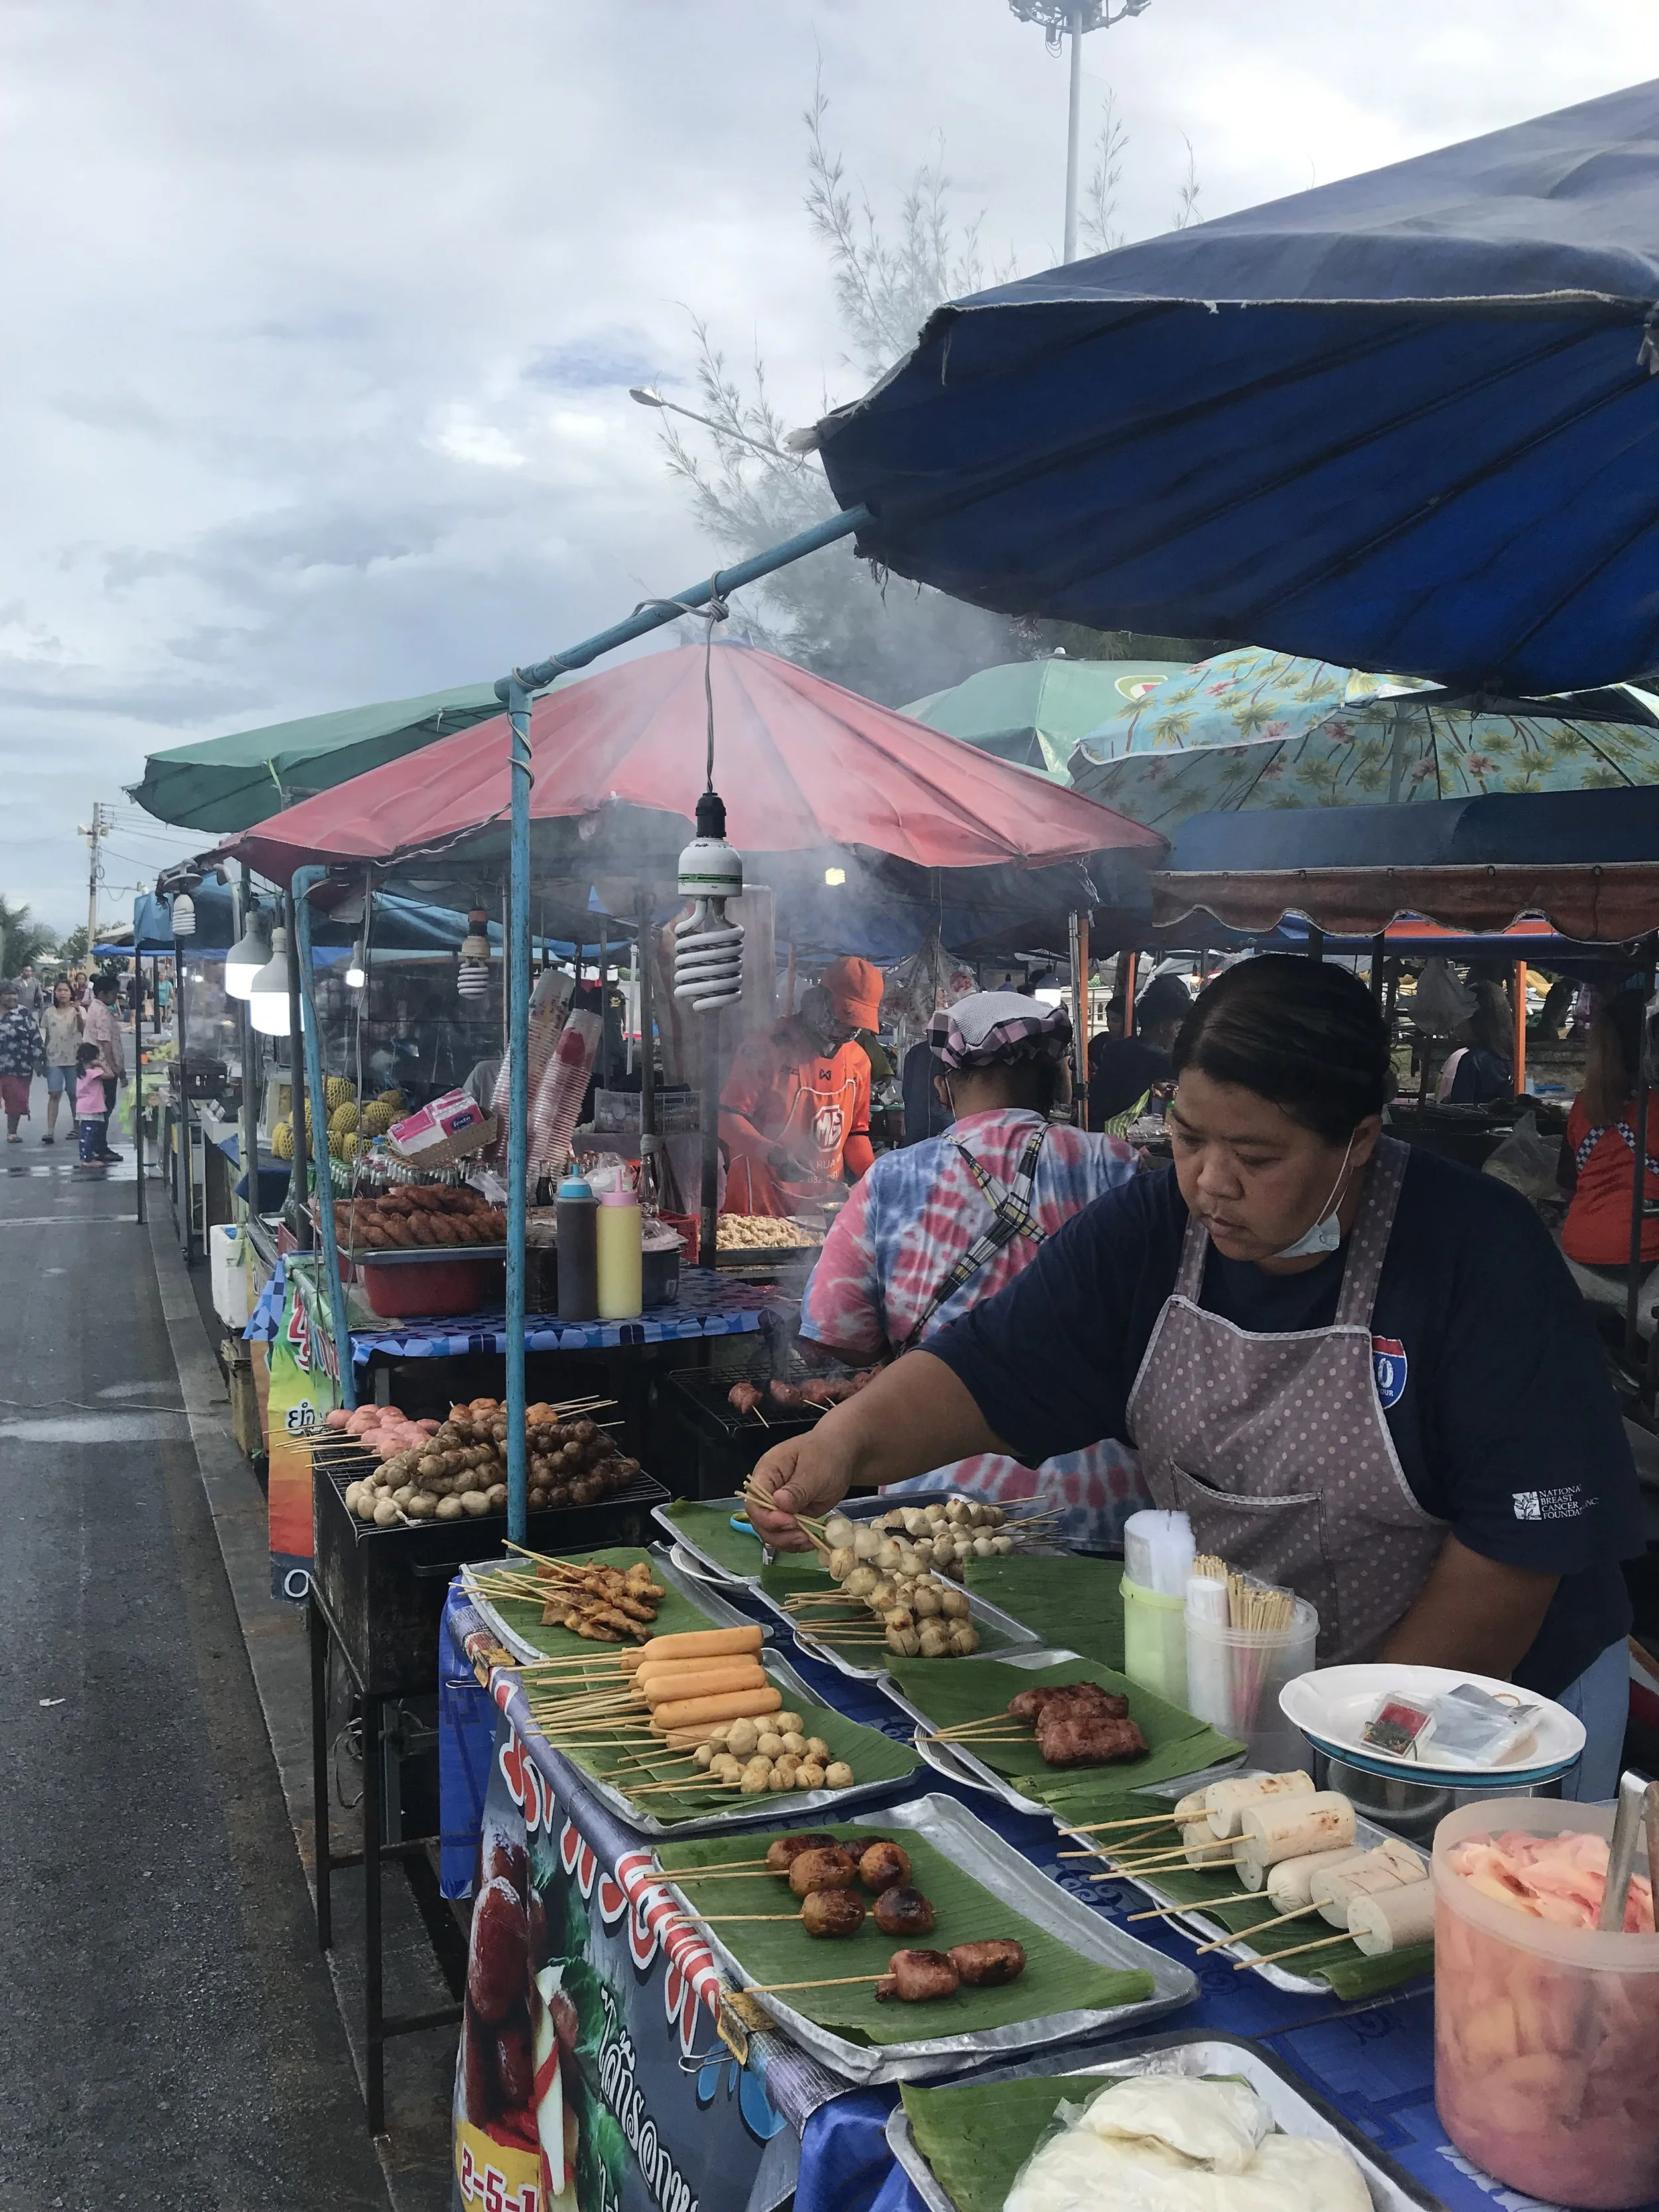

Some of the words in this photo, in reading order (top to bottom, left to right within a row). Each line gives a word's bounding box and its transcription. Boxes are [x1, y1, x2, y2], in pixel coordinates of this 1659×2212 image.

[816, 1111, 842, 1147] MG
[1538, 1484, 1581, 1498] NATIONA
[1540, 1494, 1573, 1506] BREAST
[1542, 1501, 1579, 1512] CANCER
